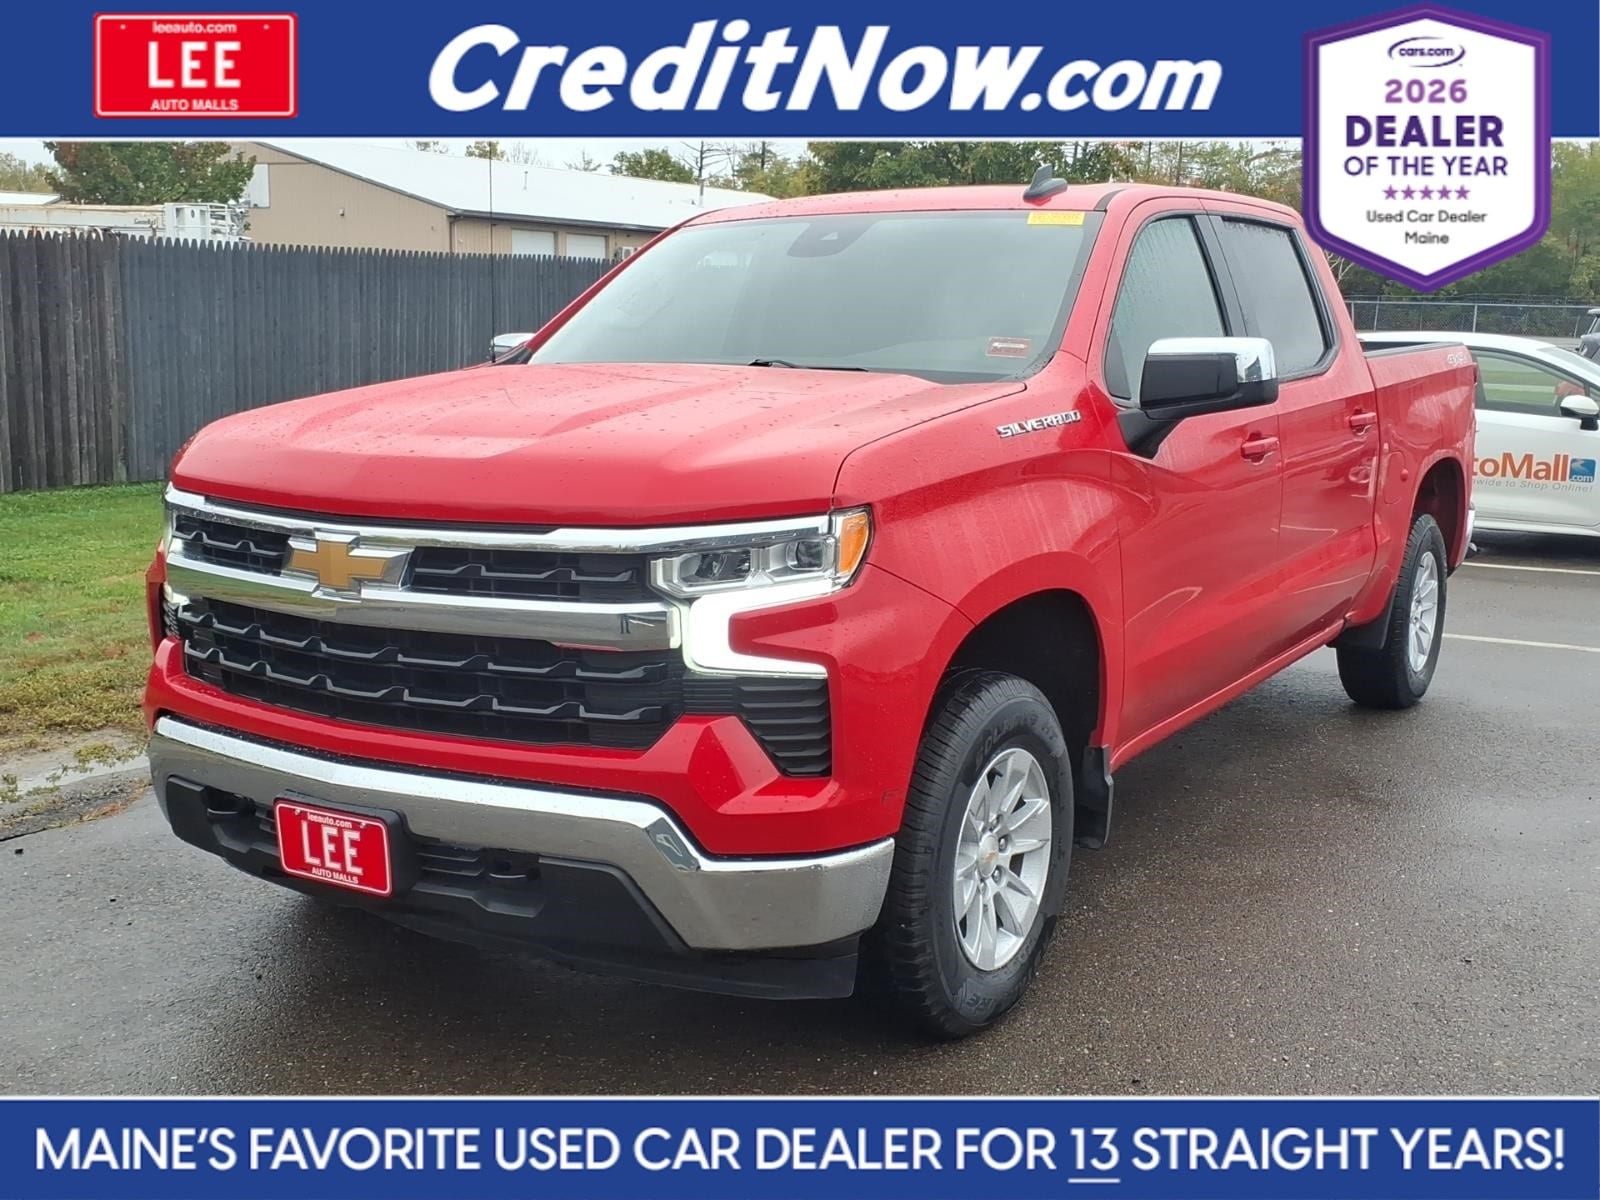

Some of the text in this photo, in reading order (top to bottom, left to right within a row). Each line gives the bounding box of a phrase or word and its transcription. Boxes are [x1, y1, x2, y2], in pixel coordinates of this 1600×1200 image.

[996, 409, 1081, 438] SILVERADO
[307, 812, 353, 829] leeauto.com
[301, 820, 364, 875] LEE
[311, 867, 359, 884] AUTO MALLS
